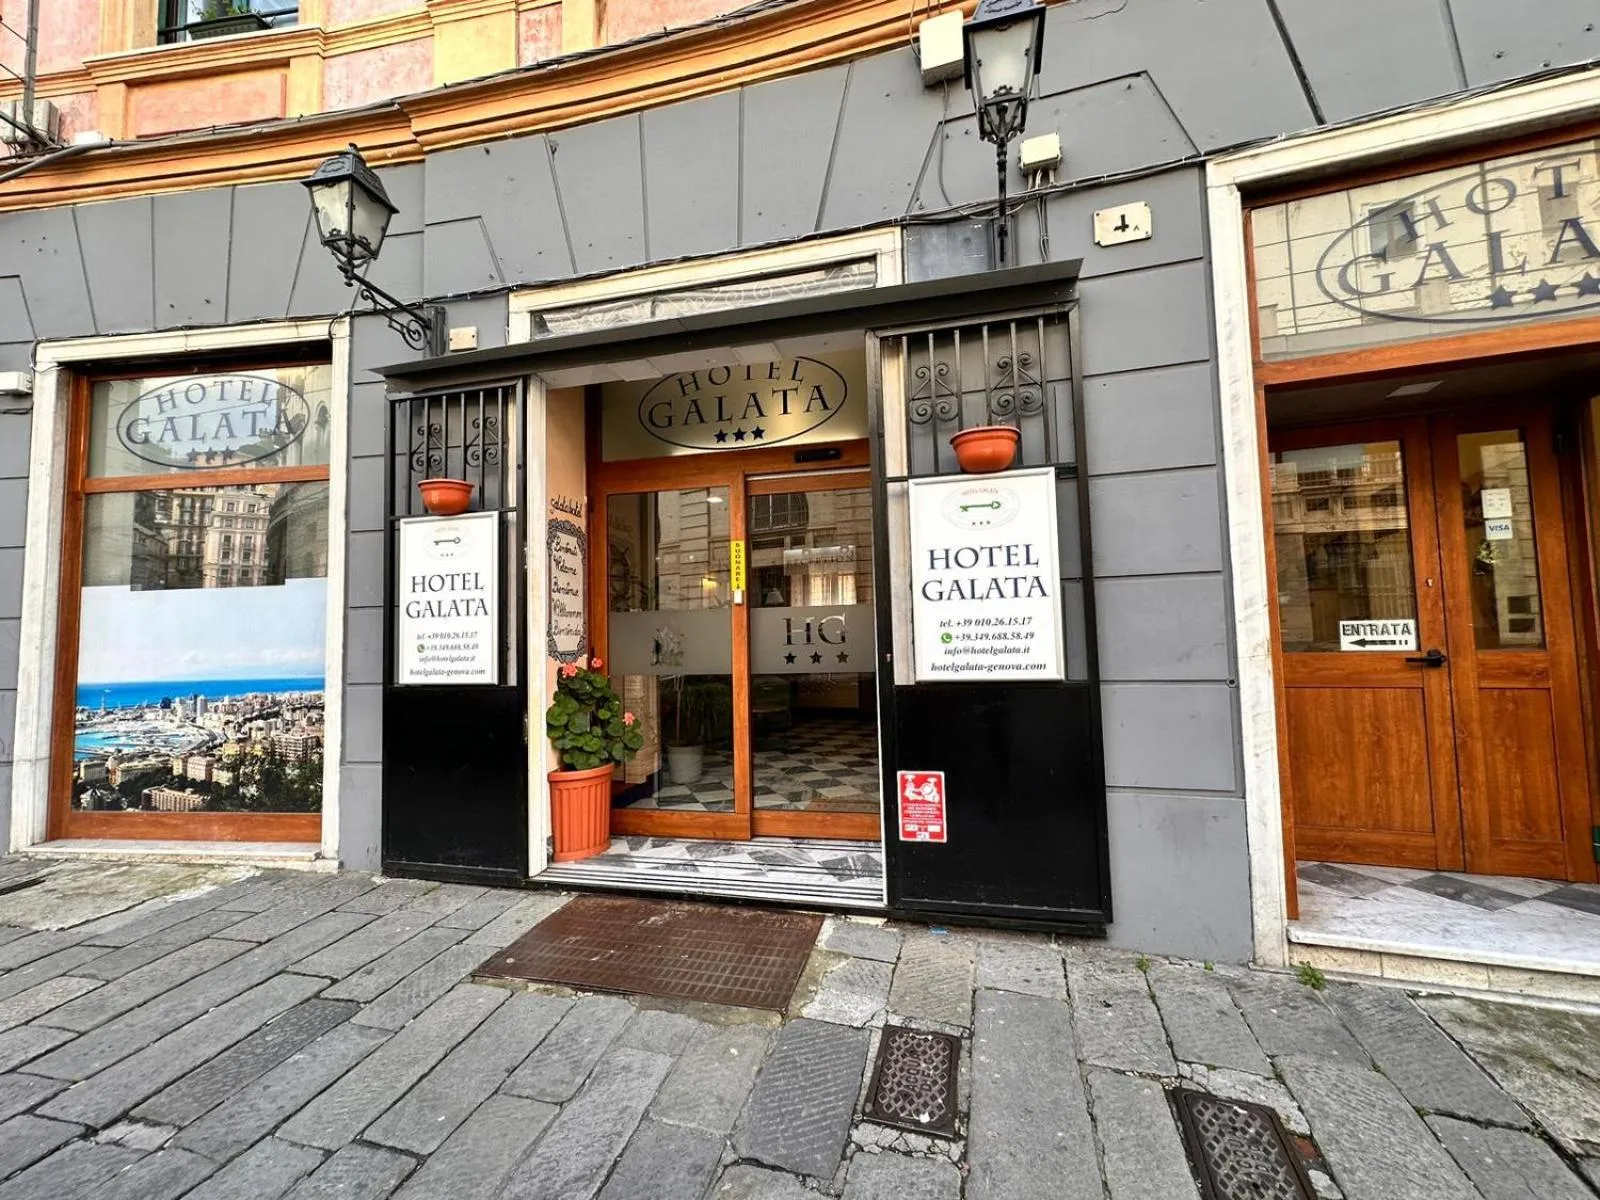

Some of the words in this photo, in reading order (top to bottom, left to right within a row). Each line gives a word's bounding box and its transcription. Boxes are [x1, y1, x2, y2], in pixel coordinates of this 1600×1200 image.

[154, 379, 276, 416] HOTEL
[648, 384, 833, 429] GALATA
[126, 408, 297, 445] GALATA
[1489, 524, 1510, 532] VISA
[928, 543, 1040, 571] HOTEL
[411, 572, 485, 593] HOTEL
[921, 575, 1050, 603] GALATA
[405, 598, 489, 619] GALATA
[782, 612, 847, 646] HG
[956, 618, 973, 628] +39
[974, 616, 1033, 627] 010.26.15.17
[1342, 623, 1411, 637] ENTRATA
[955, 631, 1035, 642] +39.349.688.58.49
[944, 645, 1031, 657] info@hotelgalata.it
[930, 661, 1047, 673] hotelgalata-genova.com
